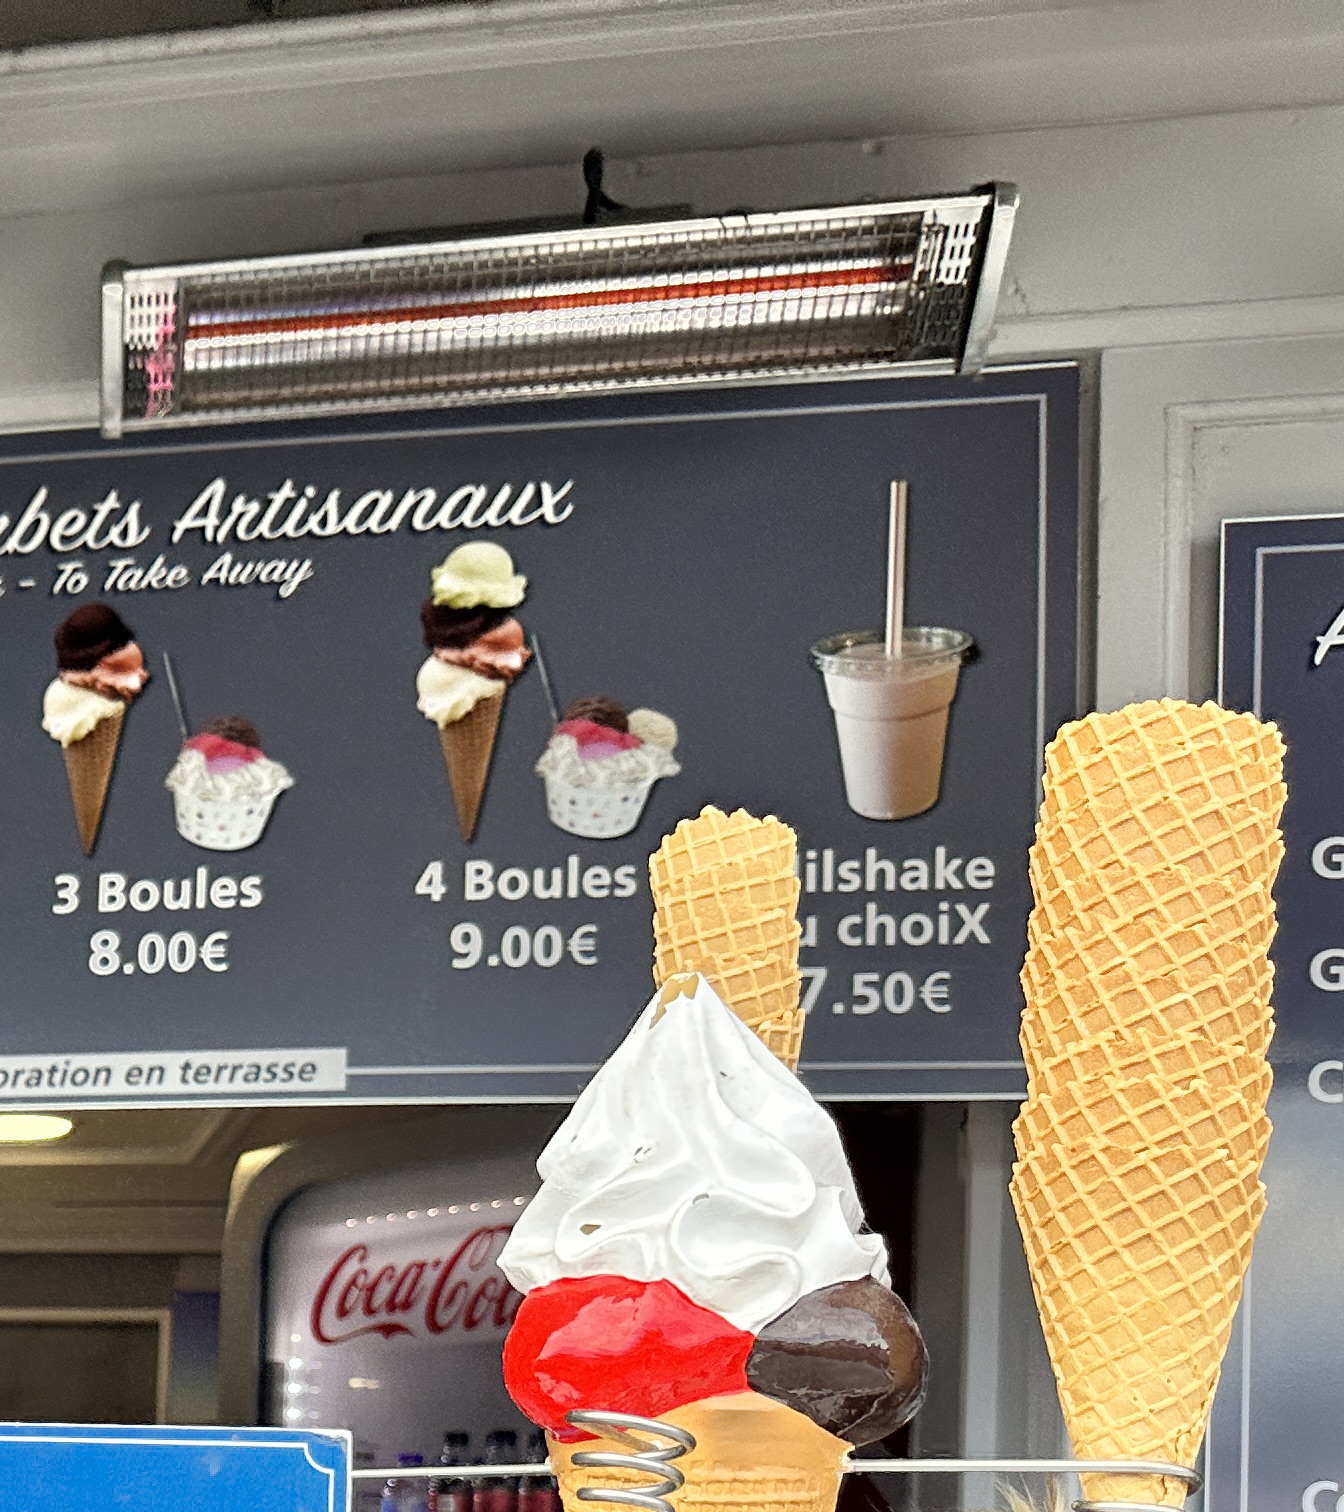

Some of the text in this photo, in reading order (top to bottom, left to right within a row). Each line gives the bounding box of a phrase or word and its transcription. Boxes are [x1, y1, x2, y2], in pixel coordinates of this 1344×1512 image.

[172, 478, 573, 543] Artisanaux
[53, 561, 88, 593] To
[105, 555, 189, 590] Take
[202, 552, 313, 597] Away
[53, 866, 262, 914] 3 Boules
[415, 855, 637, 901] 4 Boules
[796, 845, 996, 893] ilshake
[450, 923, 597, 968] 9.00€
[838, 901, 990, 946] choiX
[89, 930, 228, 975] 8.00€
[123, 1063, 164, 1086] en
[178, 1059, 317, 1085] terrasse
